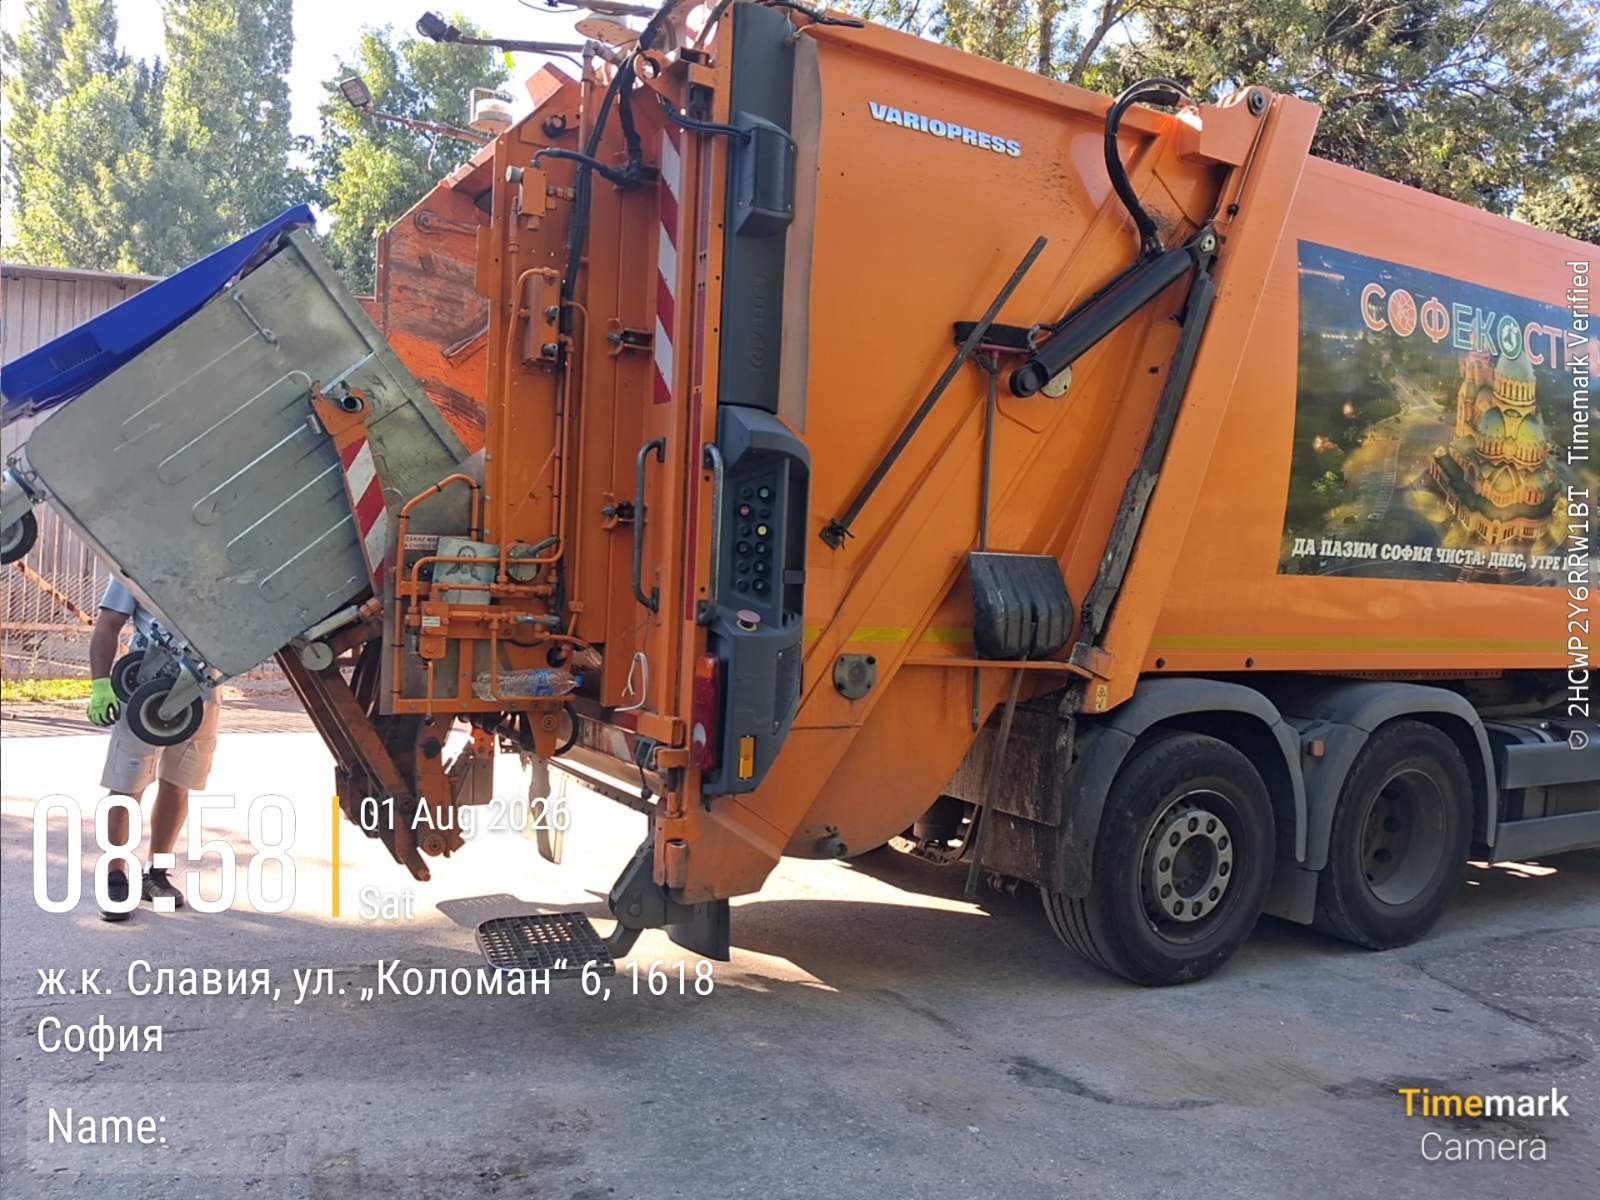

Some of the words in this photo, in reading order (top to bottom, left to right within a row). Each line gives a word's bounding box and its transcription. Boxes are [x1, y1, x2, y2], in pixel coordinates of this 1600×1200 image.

[868, 100, 1022, 158] VARIOPRESS
[1291, 537, 1316, 558] ДА
[1319, 539, 1378, 560] ПАЗИМ
[1380, 543, 1433, 563] СОФИЯ
[1436, 548, 1486, 566] ЧИСТА:
[1488, 551, 1527, 572] ДНЕС,
[1529, 554, 1561, 571] УТРЕ
